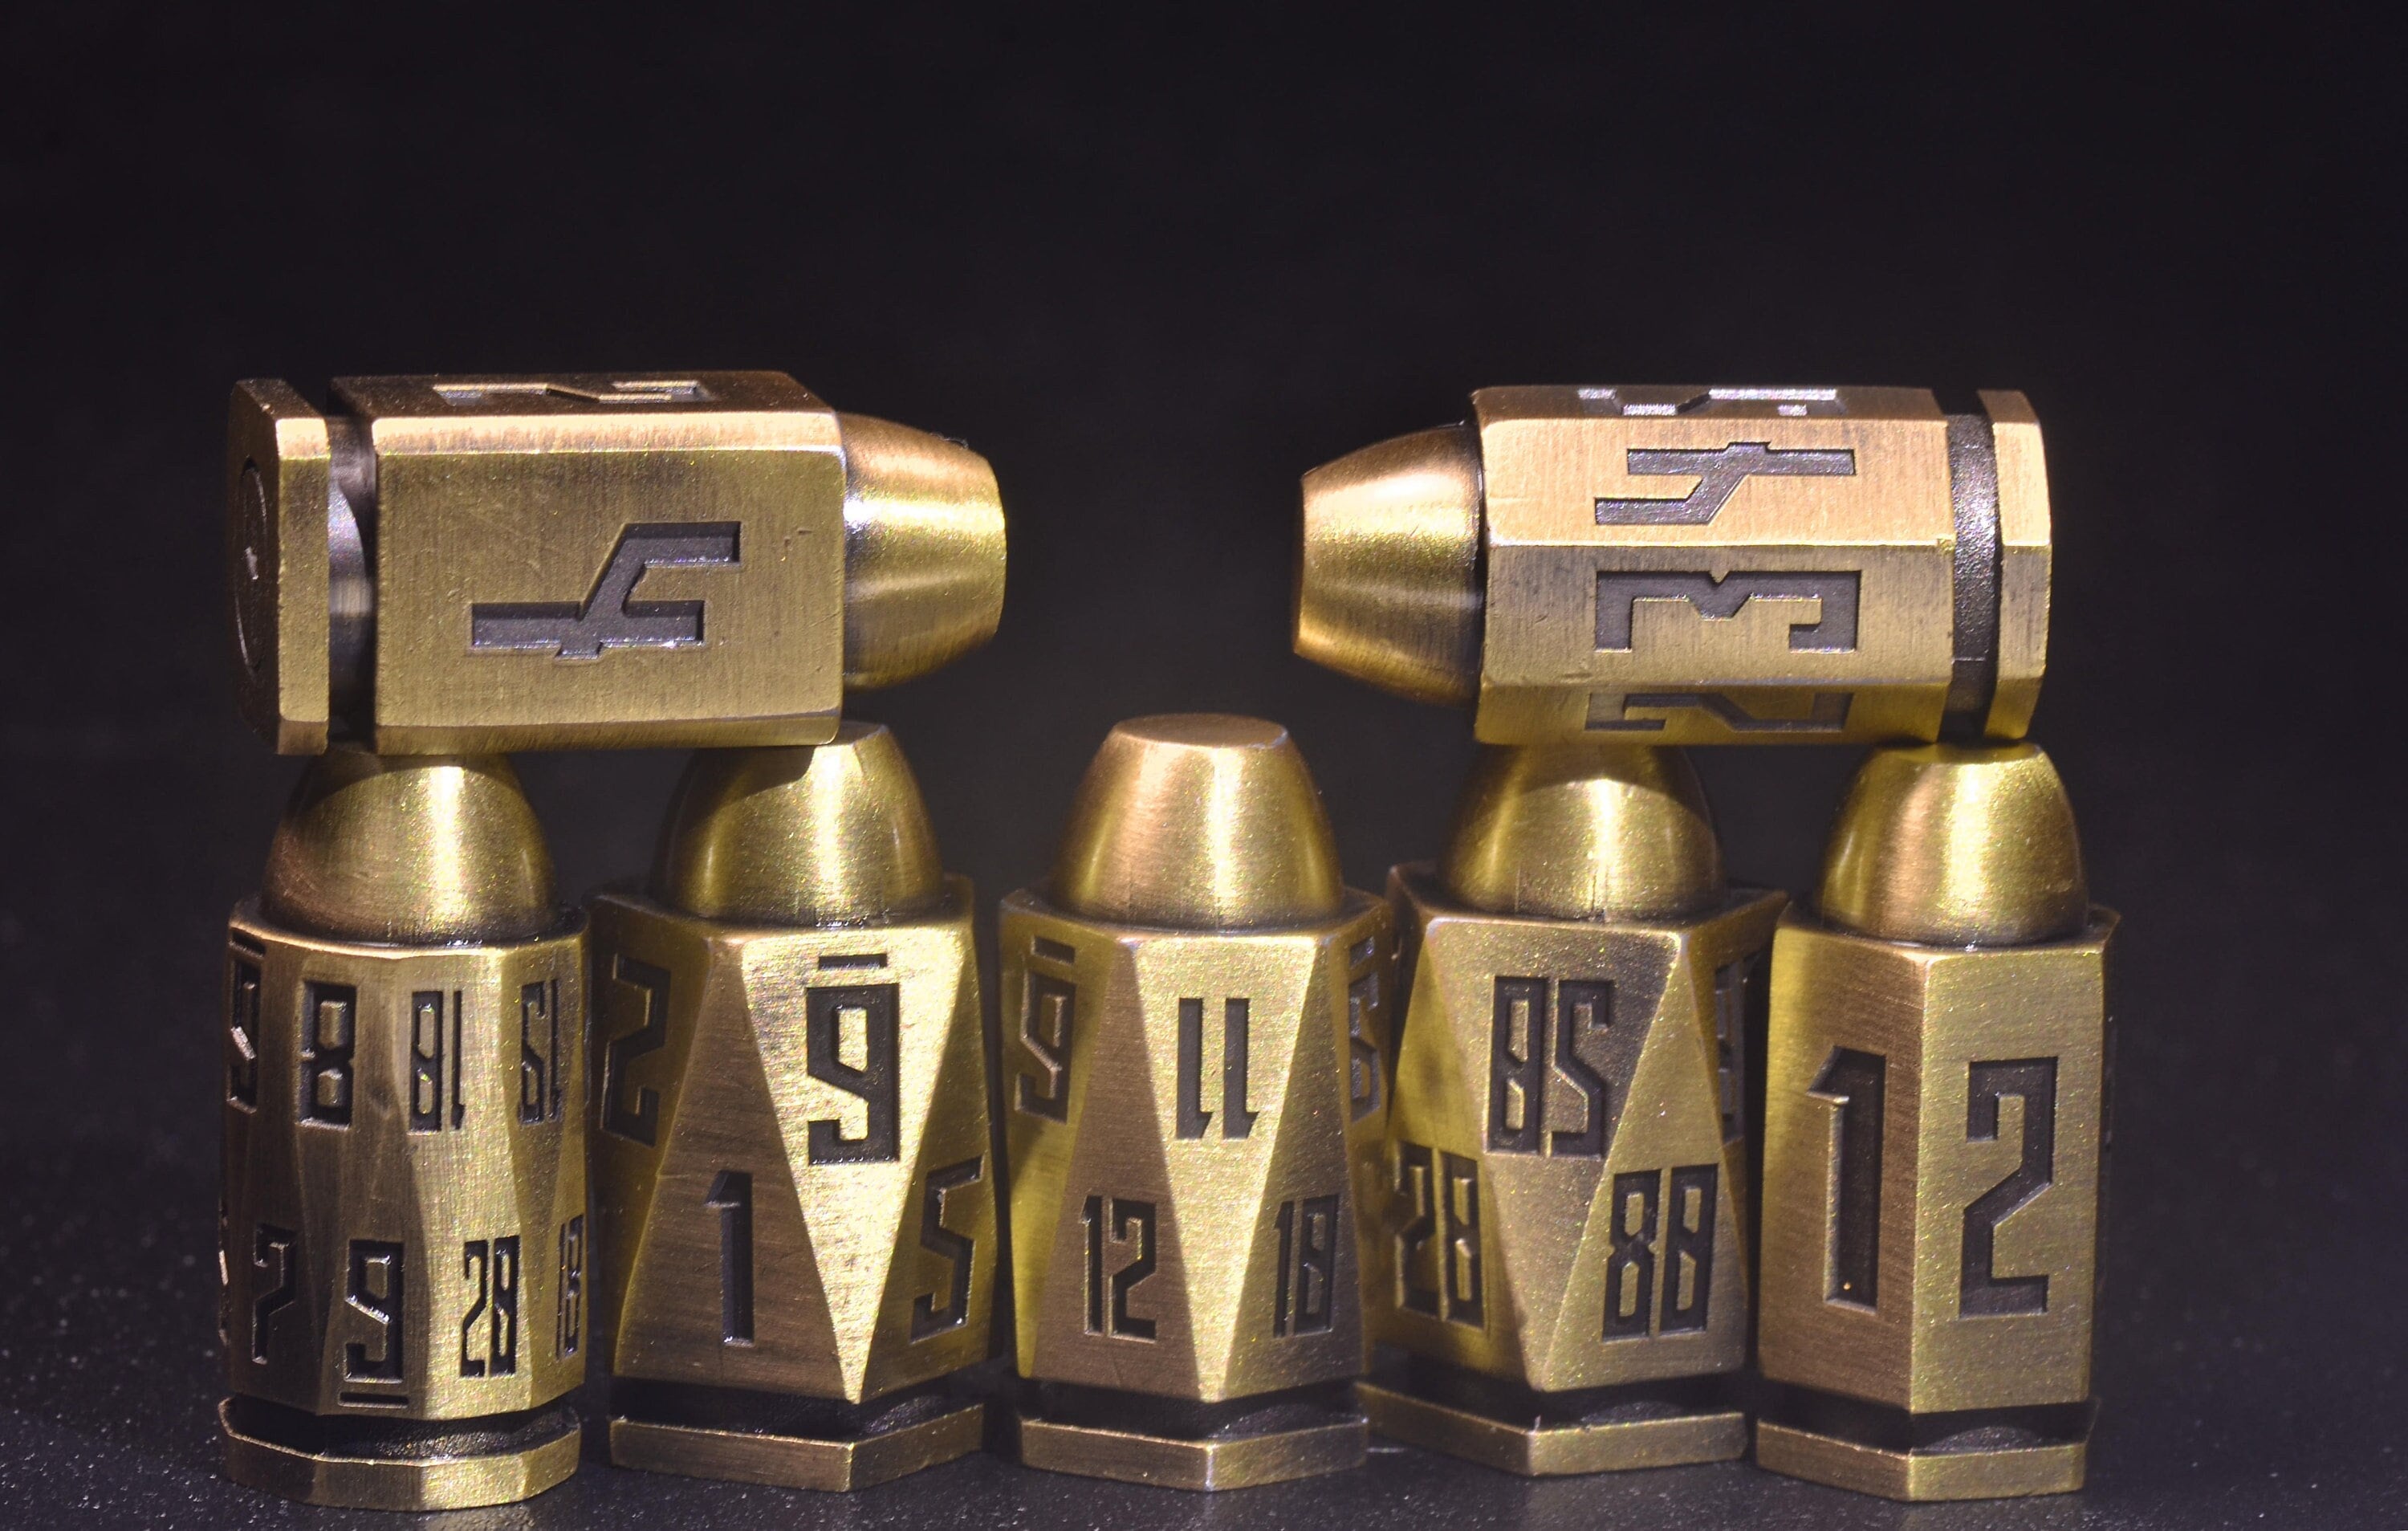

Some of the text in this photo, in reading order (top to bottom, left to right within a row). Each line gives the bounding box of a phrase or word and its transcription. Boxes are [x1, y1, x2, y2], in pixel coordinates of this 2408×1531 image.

[1595, 570, 1861, 653] 3
[295, 980, 357, 1130] 8
[1177, 998, 1260, 1140] 11
[705, 1170, 755, 1346] 1
[1959, 1056, 2058, 1318] 2
[1081, 1195, 1157, 1343] 12
